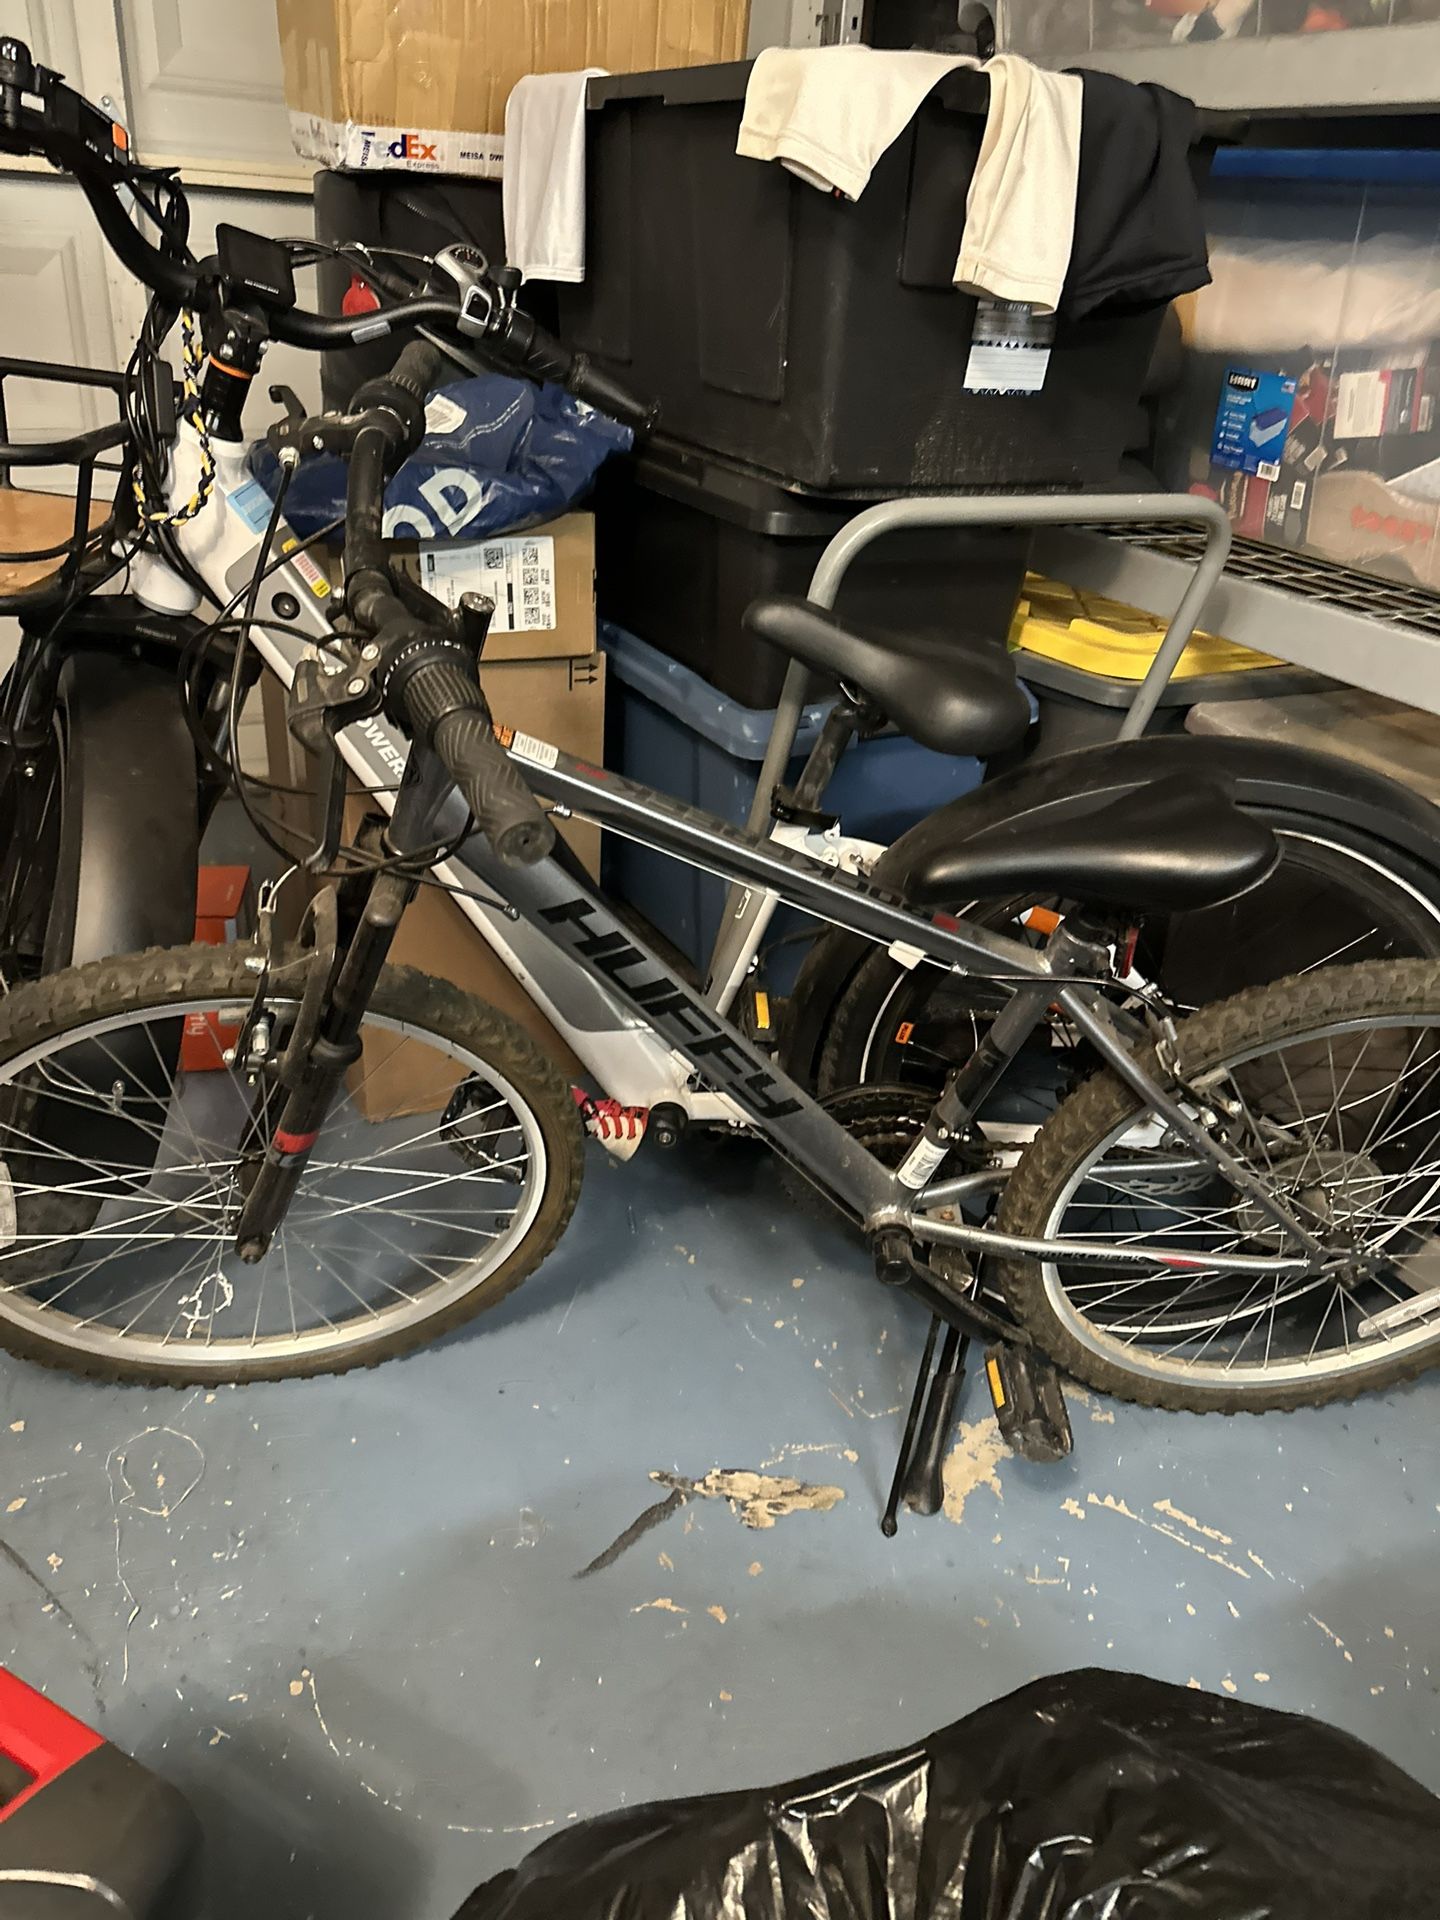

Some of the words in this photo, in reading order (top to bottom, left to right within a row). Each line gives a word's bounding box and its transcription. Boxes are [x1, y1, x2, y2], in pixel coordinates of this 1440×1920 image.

[362, 132, 437, 161] edEx
[460, 151, 484, 160] MEISA
[406, 160, 440, 169] Express
[537, 898, 805, 1119] HUFFY
